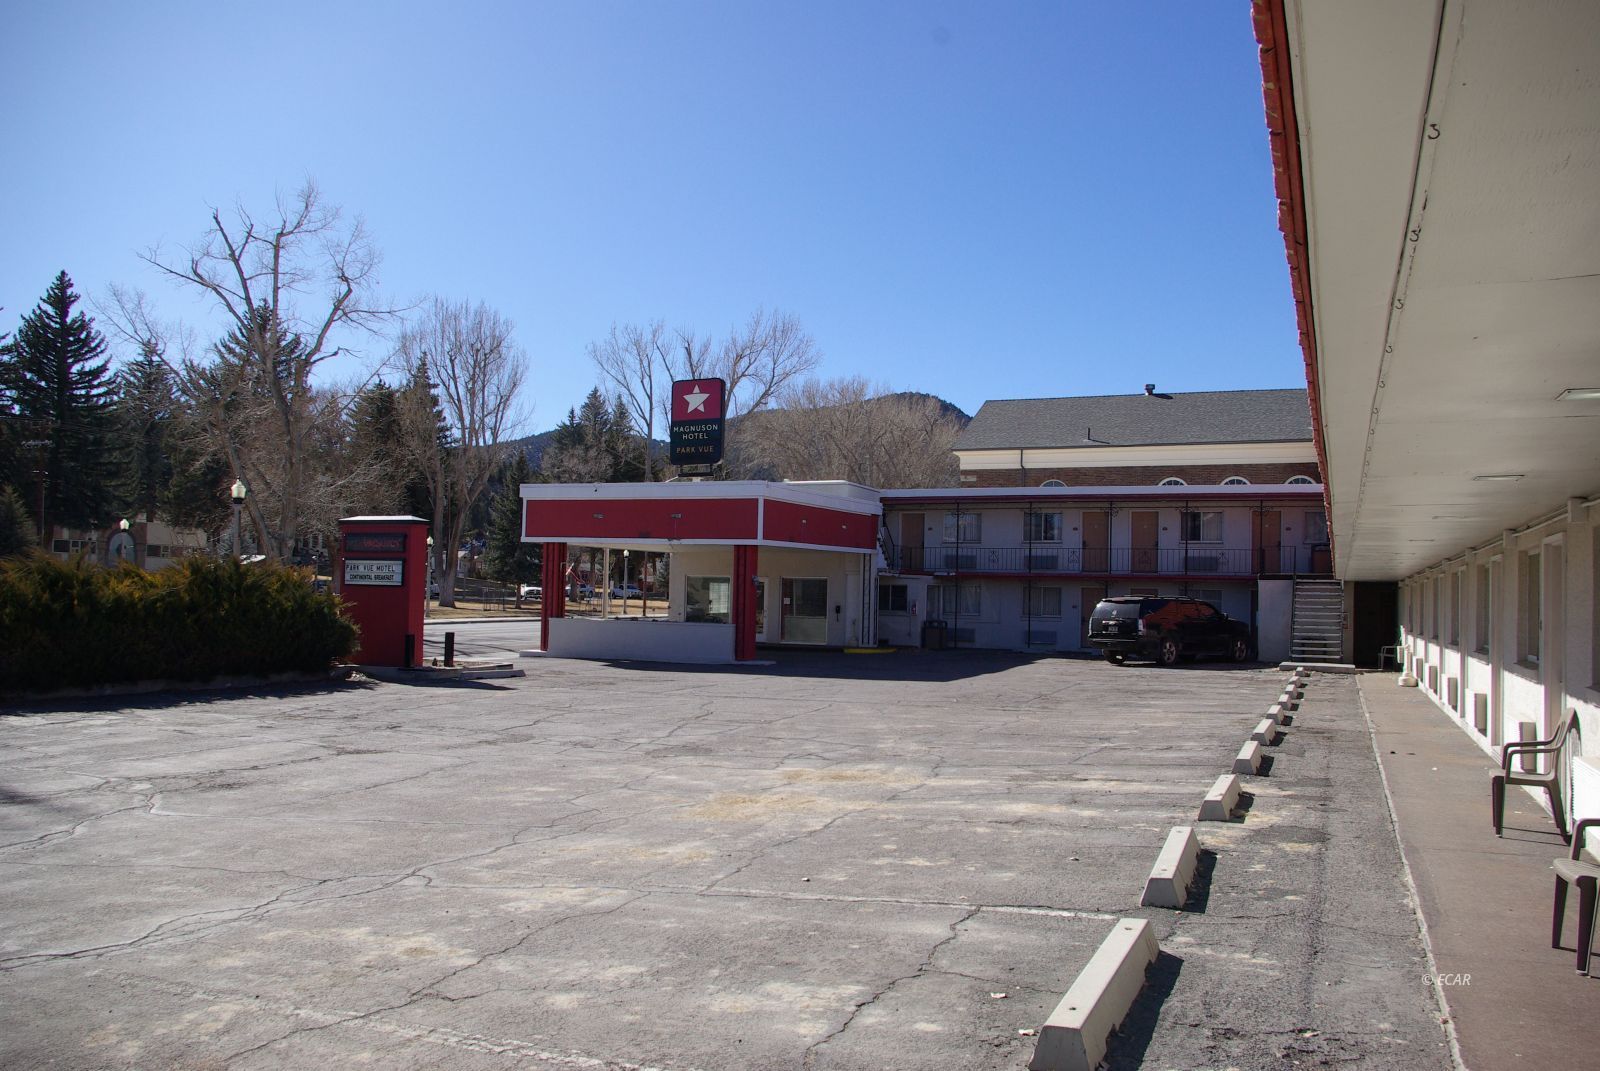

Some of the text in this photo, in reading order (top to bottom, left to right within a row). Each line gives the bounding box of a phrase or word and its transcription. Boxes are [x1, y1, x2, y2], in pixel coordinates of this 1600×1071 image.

[673, 424, 718, 433] MAGNUSON
[682, 432, 708, 440] HOTEL
[676, 445, 715, 454] PARK VUE
[377, 564, 395, 572] MOTEL
